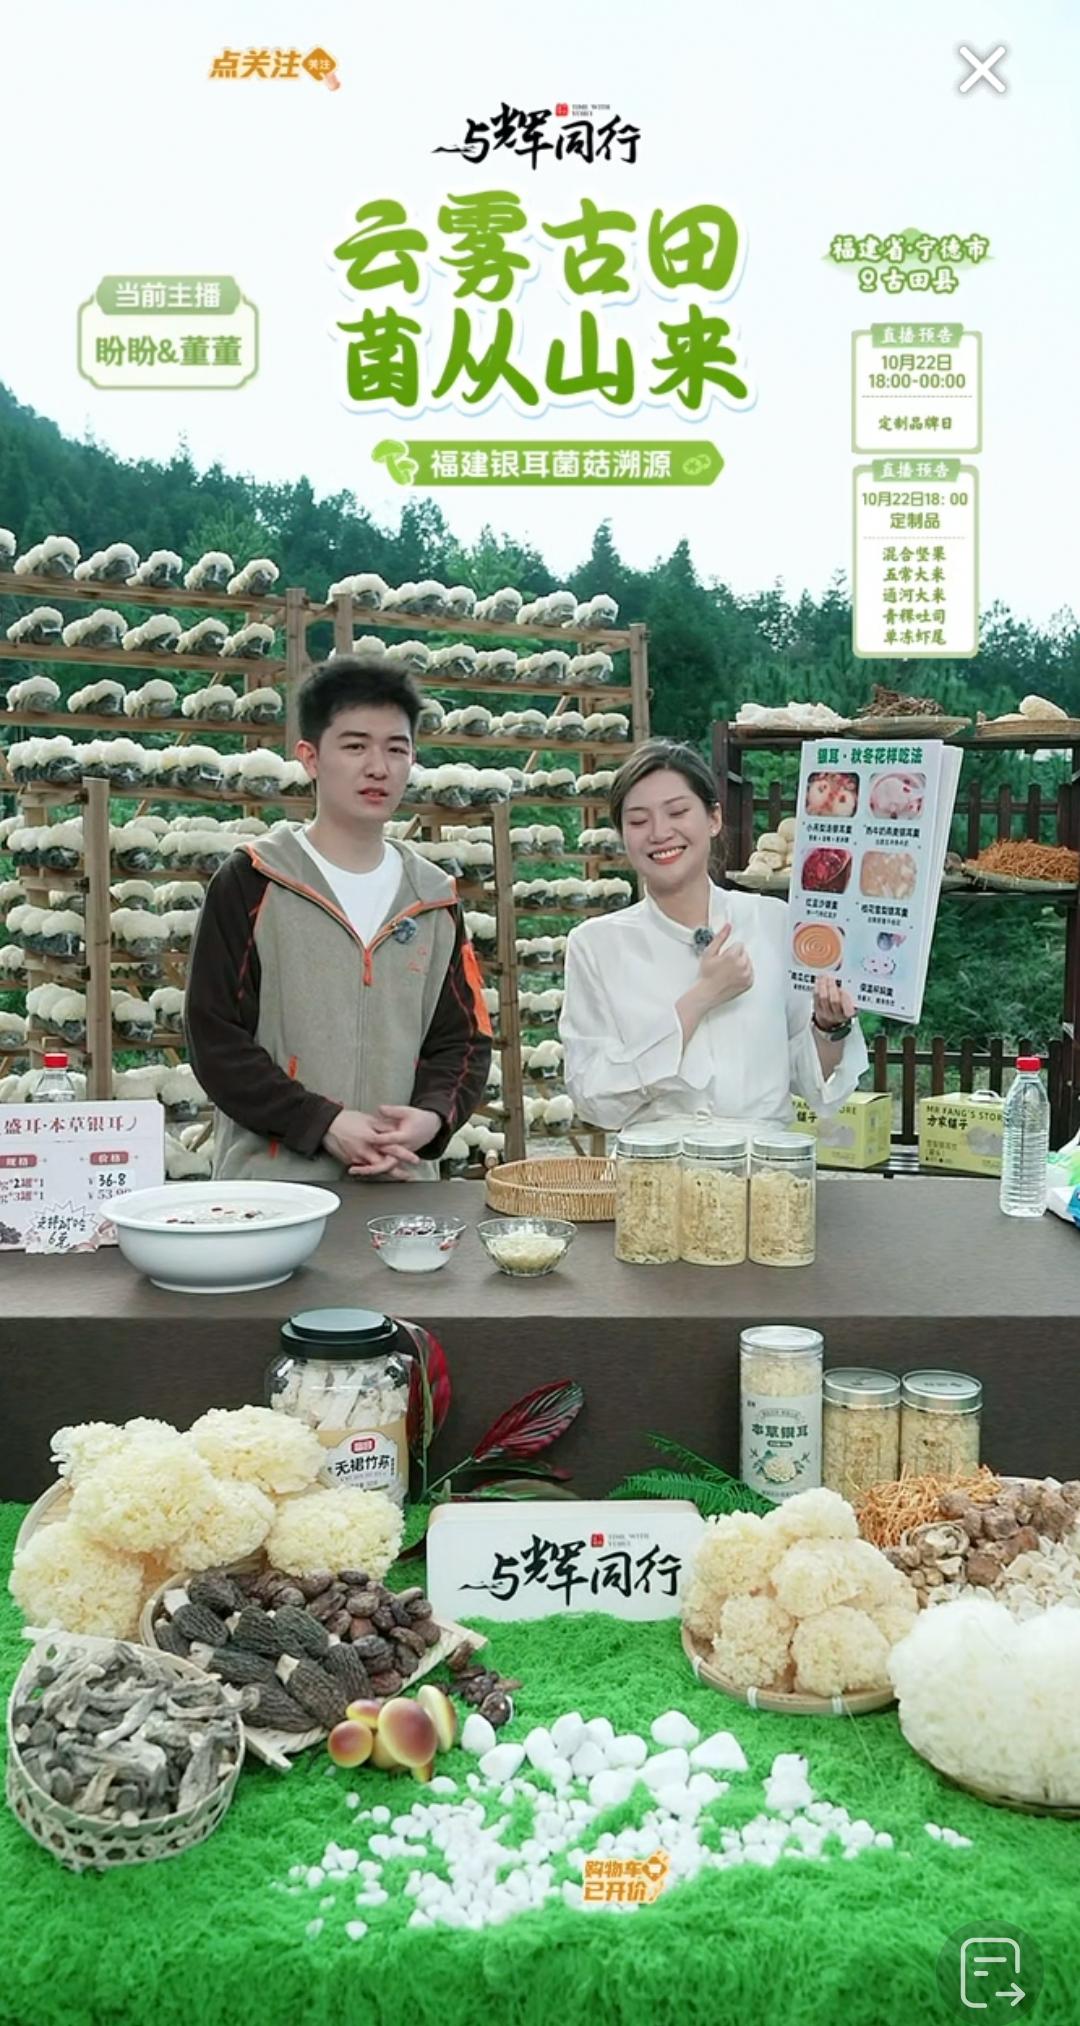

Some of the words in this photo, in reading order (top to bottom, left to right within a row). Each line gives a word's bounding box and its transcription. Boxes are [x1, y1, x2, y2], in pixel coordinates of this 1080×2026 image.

[943, 1107, 976, 1119] FANG'S
[978, 1111, 1002, 1122] STOR
[5, 1156, 29, 1167] 规格
[97, 1153, 122, 1163] 价格
[458, 1533, 683, 1607] 与辉同行
